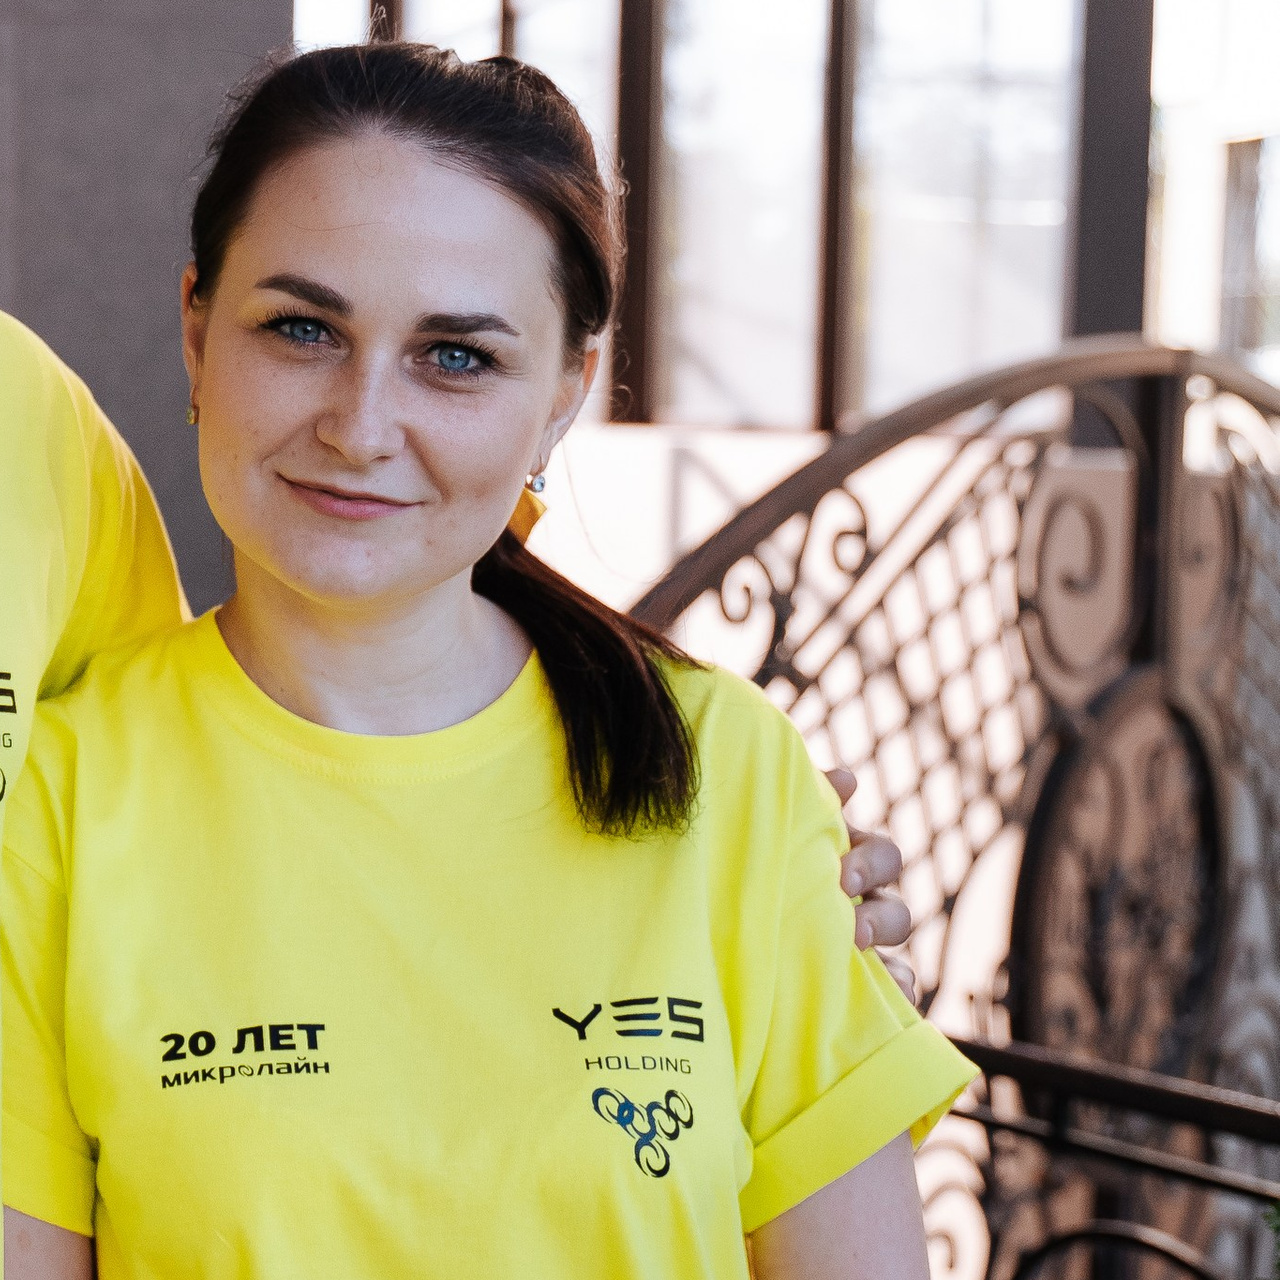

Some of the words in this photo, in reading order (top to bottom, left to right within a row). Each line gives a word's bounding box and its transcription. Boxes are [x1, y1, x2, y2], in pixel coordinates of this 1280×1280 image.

[551, 996, 705, 1043] YES
[159, 1030, 217, 1063] 20
[231, 1023, 326, 1055] ЛЕТ
[160, 1056, 331, 1089] микролайн
[584, 1055, 691, 1075] HOLDING
